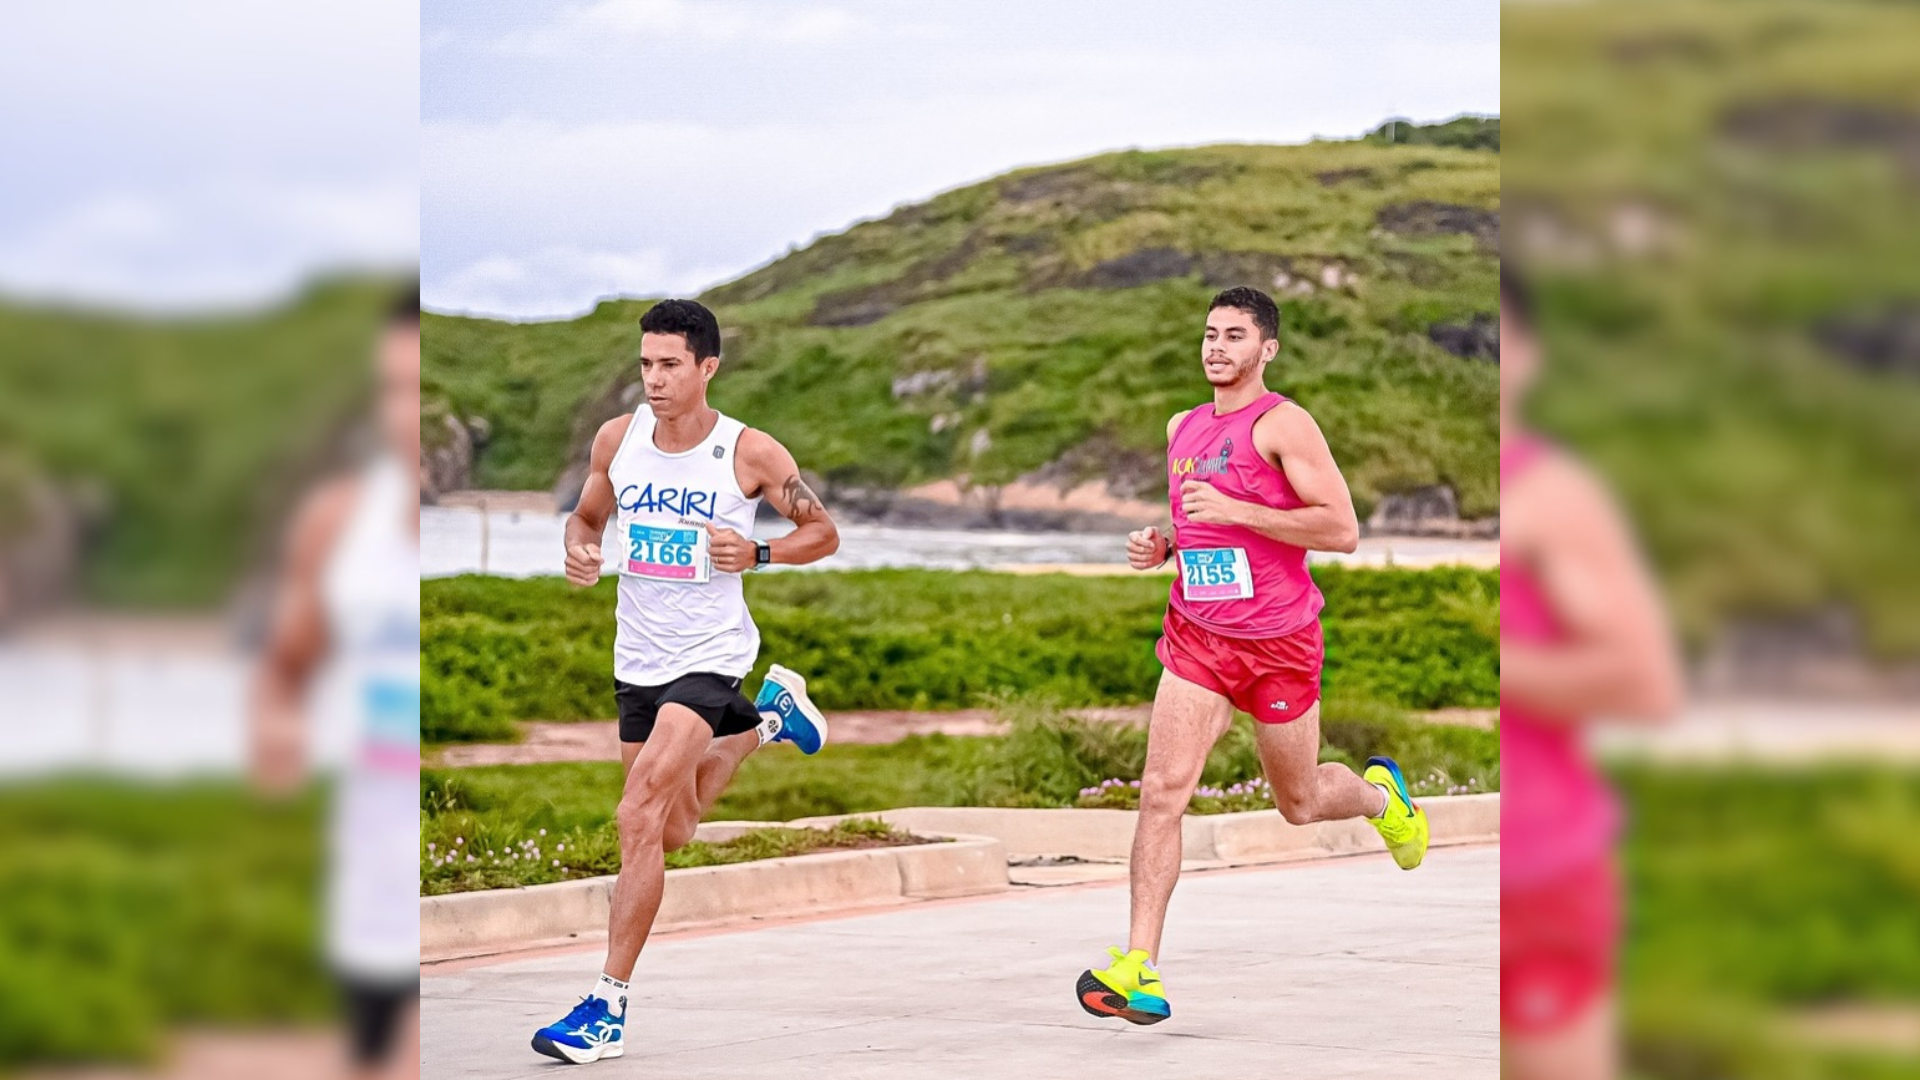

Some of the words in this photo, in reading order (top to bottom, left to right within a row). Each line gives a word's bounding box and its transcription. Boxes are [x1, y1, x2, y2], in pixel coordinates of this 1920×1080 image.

[619, 483, 717, 520] CARIRI
[630, 540, 692, 566] 2166
[1187, 564, 1236, 585] 2155
